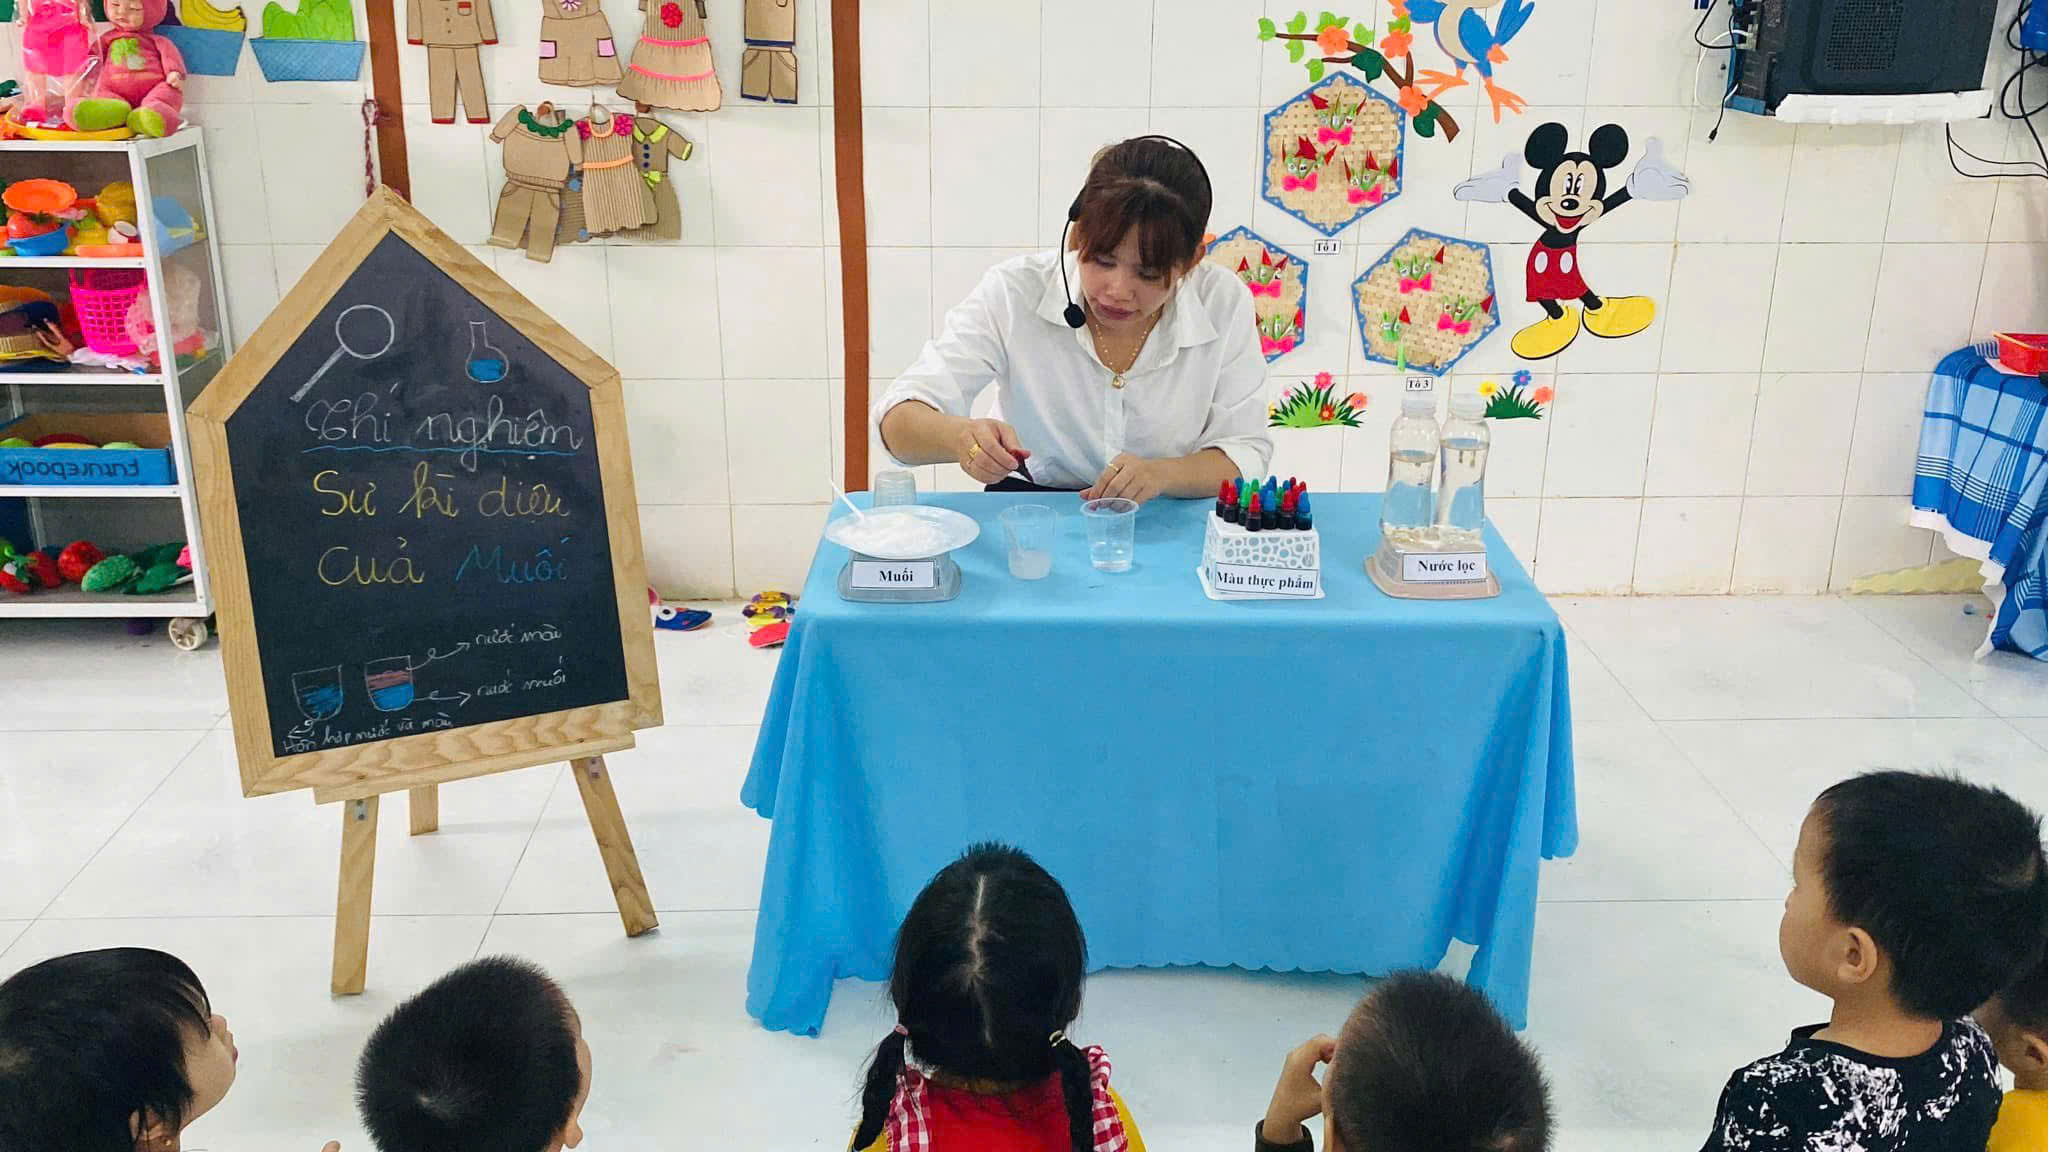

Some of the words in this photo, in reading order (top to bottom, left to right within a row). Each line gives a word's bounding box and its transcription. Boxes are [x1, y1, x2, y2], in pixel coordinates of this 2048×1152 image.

[1422, 379, 1429, 388] 3
[416, 395, 583, 472] nghiệm
[456, 537, 569, 584] Muối
[1417, 559, 1454, 572] Nước
[1457, 559, 1476, 574] lọc
[880, 566, 913, 582] Muối
[1217, 571, 1244, 585] Màu
[1248, 574, 1275, 589] thực
[1278, 574, 1313, 590] phẩm
